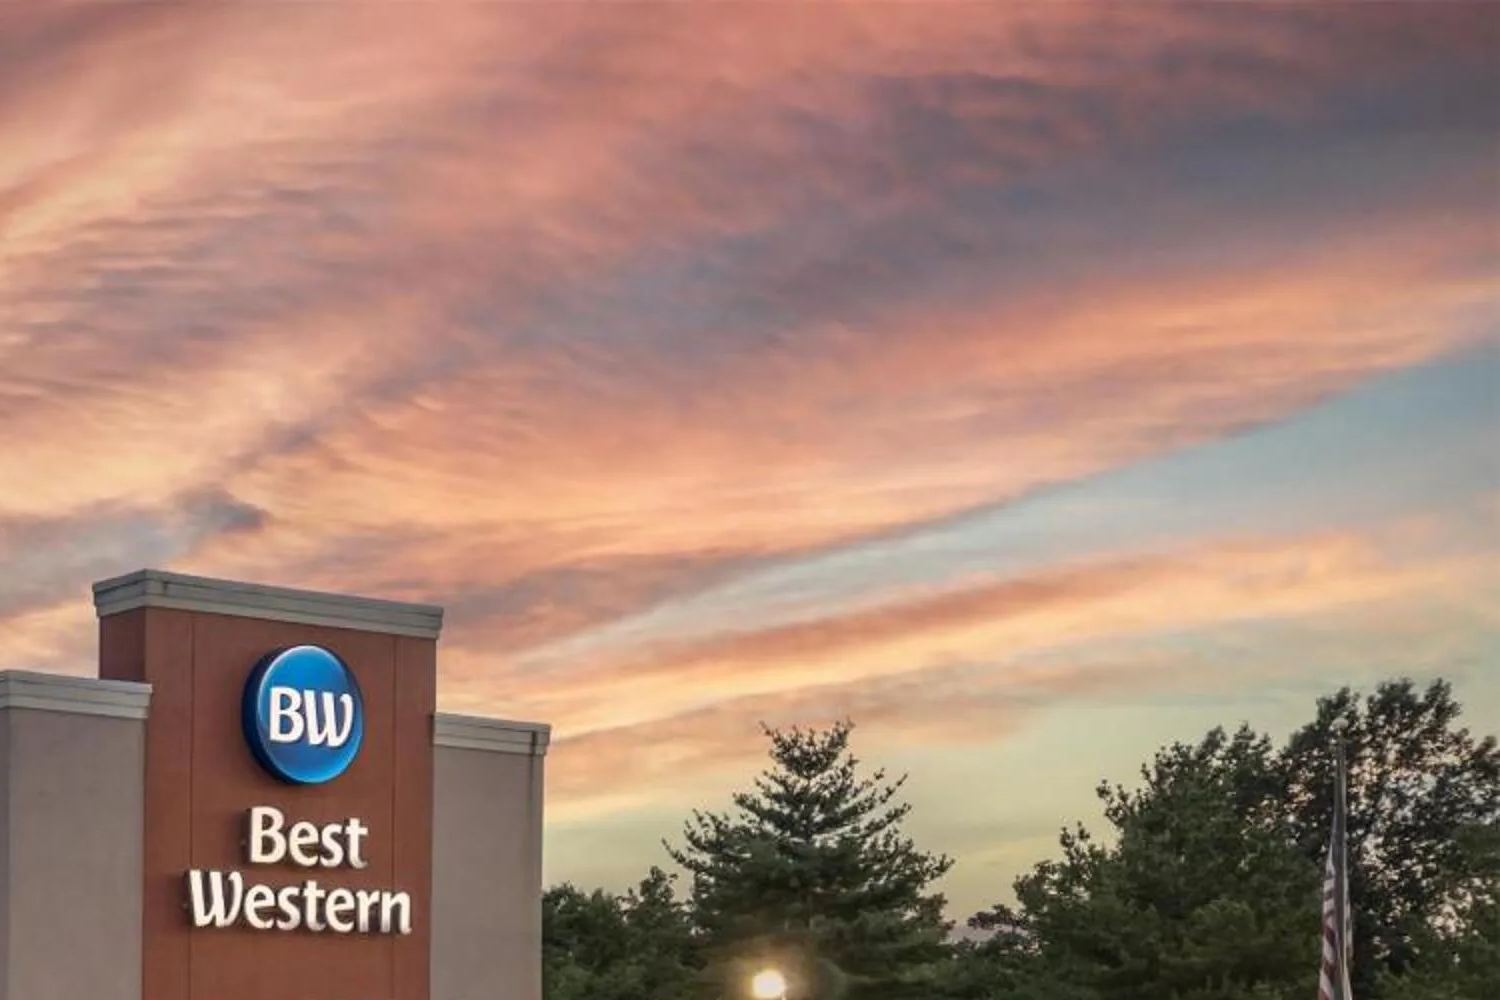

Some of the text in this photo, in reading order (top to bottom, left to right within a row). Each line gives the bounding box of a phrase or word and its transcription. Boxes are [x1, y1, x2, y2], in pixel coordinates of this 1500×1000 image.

[269, 686, 354, 747] BW
[250, 806, 368, 869] Best
[189, 869, 412, 935] Western
